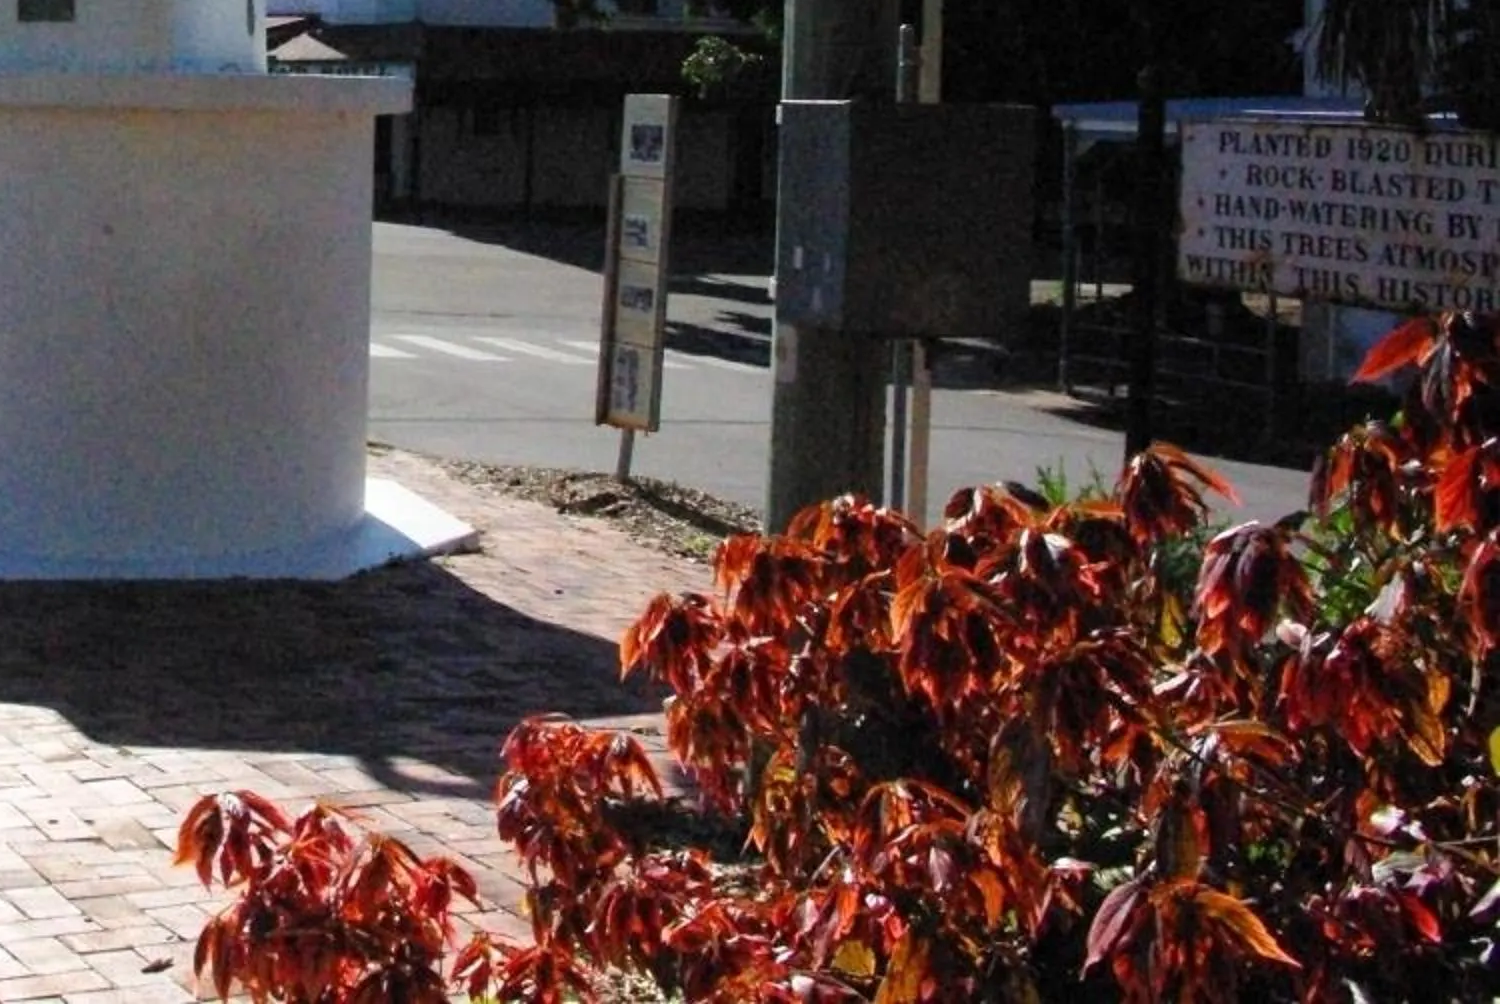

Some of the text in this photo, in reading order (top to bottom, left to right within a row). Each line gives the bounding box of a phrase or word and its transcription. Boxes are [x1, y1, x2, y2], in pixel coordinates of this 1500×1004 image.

[1219, 131, 1497, 169] PLANTED 1920 DURI
[1447, 211, 1484, 240] BY
[1214, 226, 1272, 250] THIS
[1281, 232, 1368, 263] TREES
[1186, 254, 1500, 312] WITHIN THIS HISTOR
